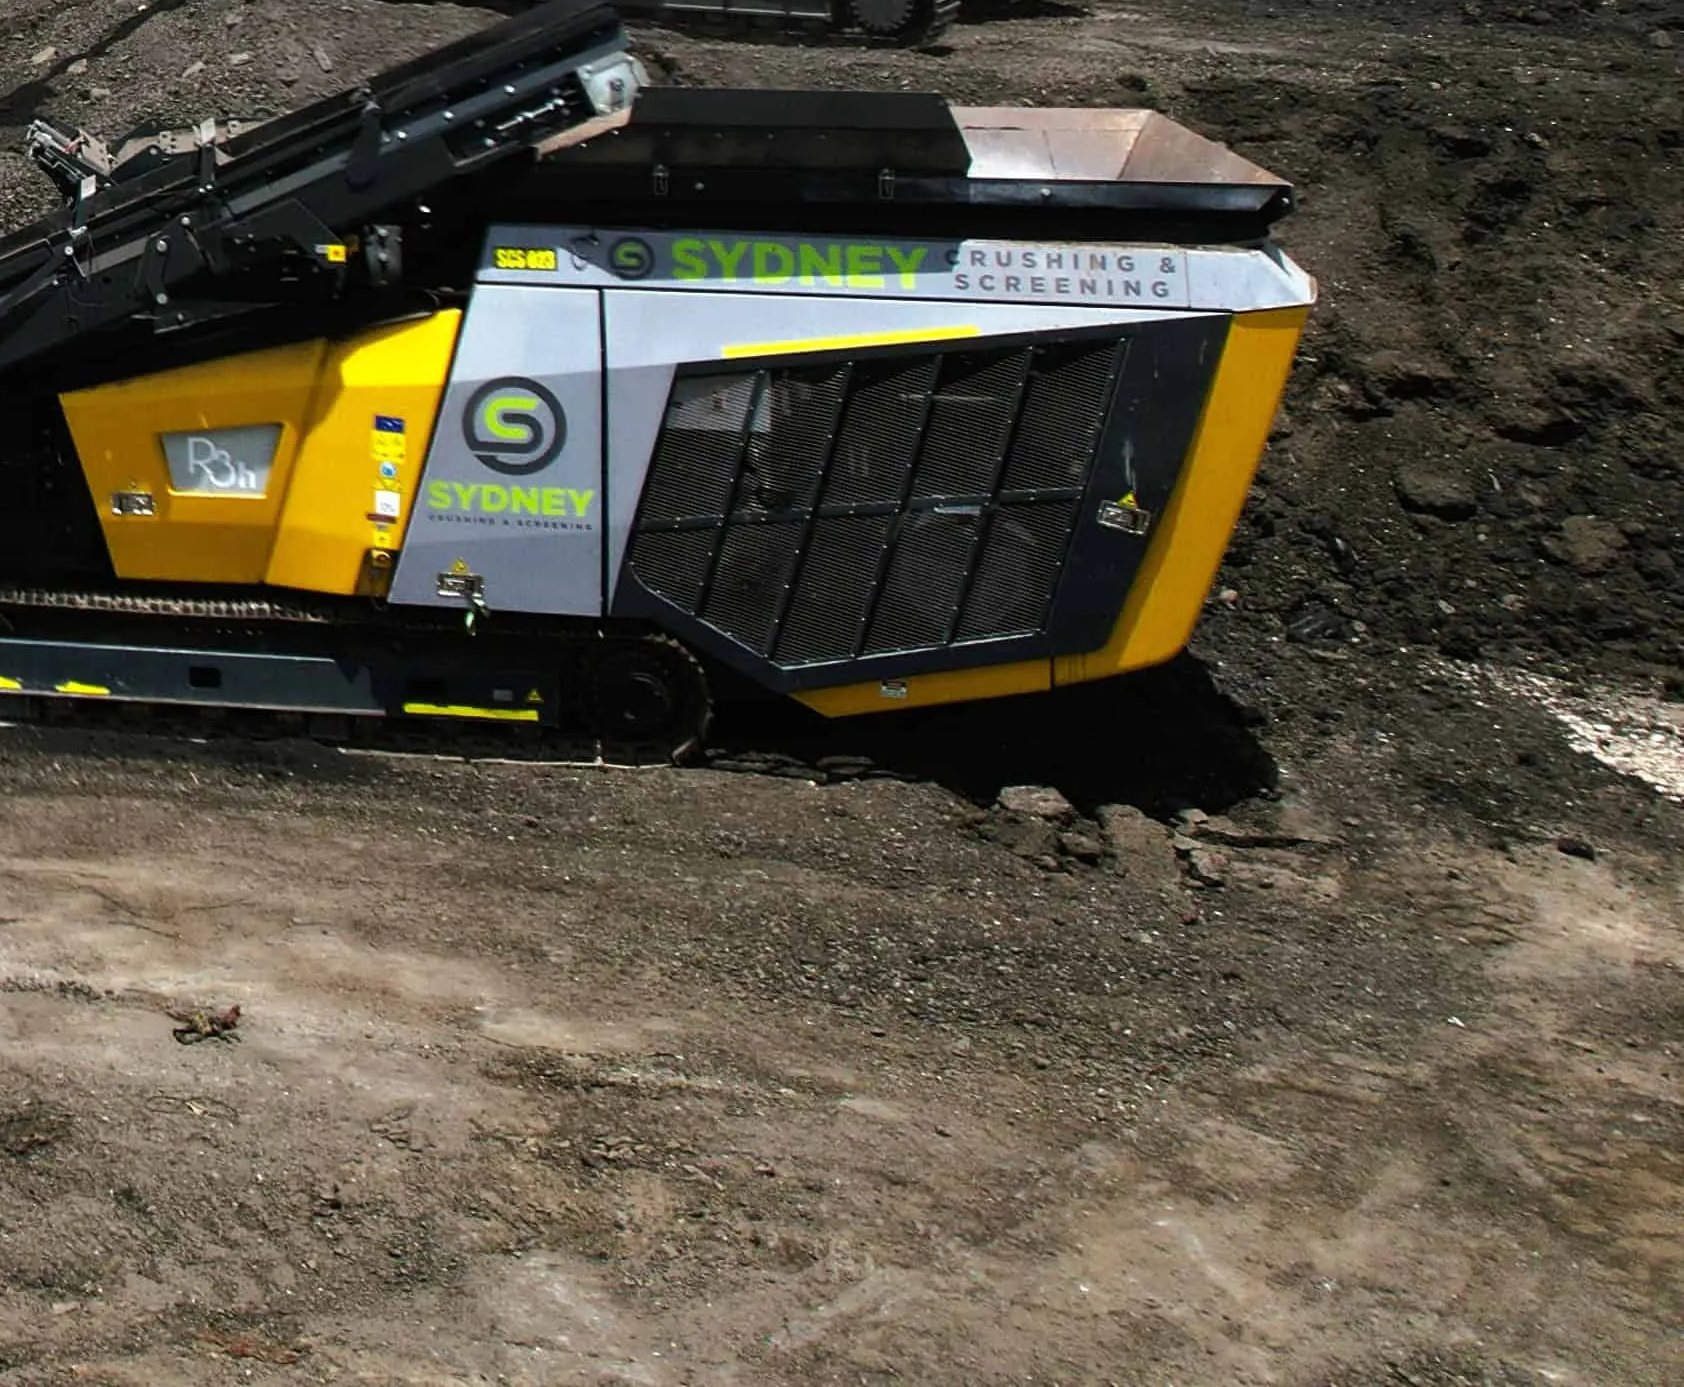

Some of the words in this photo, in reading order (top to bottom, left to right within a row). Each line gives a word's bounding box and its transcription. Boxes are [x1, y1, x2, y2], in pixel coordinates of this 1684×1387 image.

[671, 238, 929, 290] SYDNEY
[944, 250, 1135, 273] CRUSHING
[1159, 256, 1176, 274] &
[954, 273, 1170, 298] SCREENING
[426, 479, 596, 517] SYDNEY
